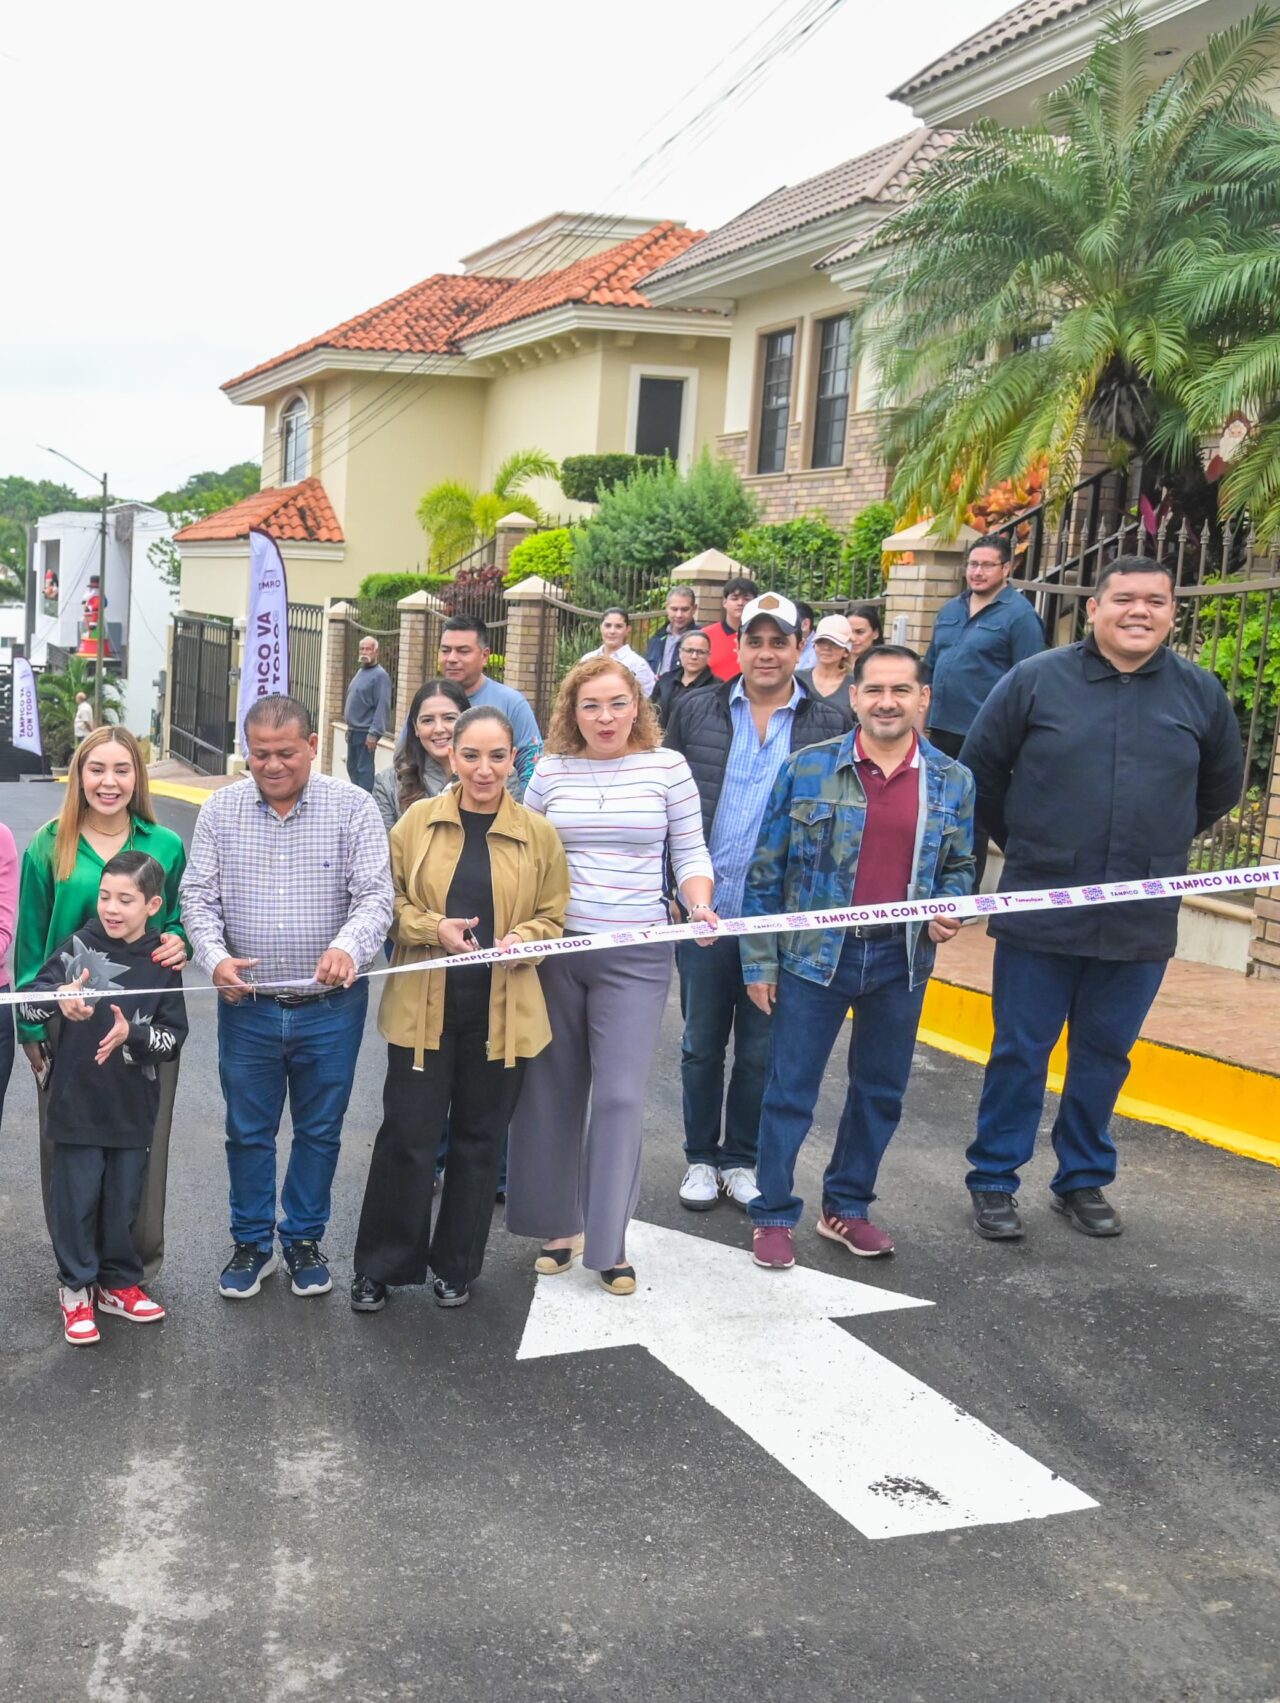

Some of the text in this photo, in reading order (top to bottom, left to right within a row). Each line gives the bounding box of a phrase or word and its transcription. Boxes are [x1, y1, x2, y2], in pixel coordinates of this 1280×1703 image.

[257, 610, 271, 697] PICO VA
[272, 623, 281, 684] TODO
[1110, 889, 1139, 897] TAMPICO
[1169, 876, 1222, 892] TAMPICO
[1225, 875, 1242, 885] VA
[1244, 871, 1270, 883] CON
[814, 903, 956, 924] TAMPICO VA CON TODO
[444, 951, 501, 964] TAMPICO
[524, 944, 552, 953] CON
[557, 939, 592, 949] TODO
